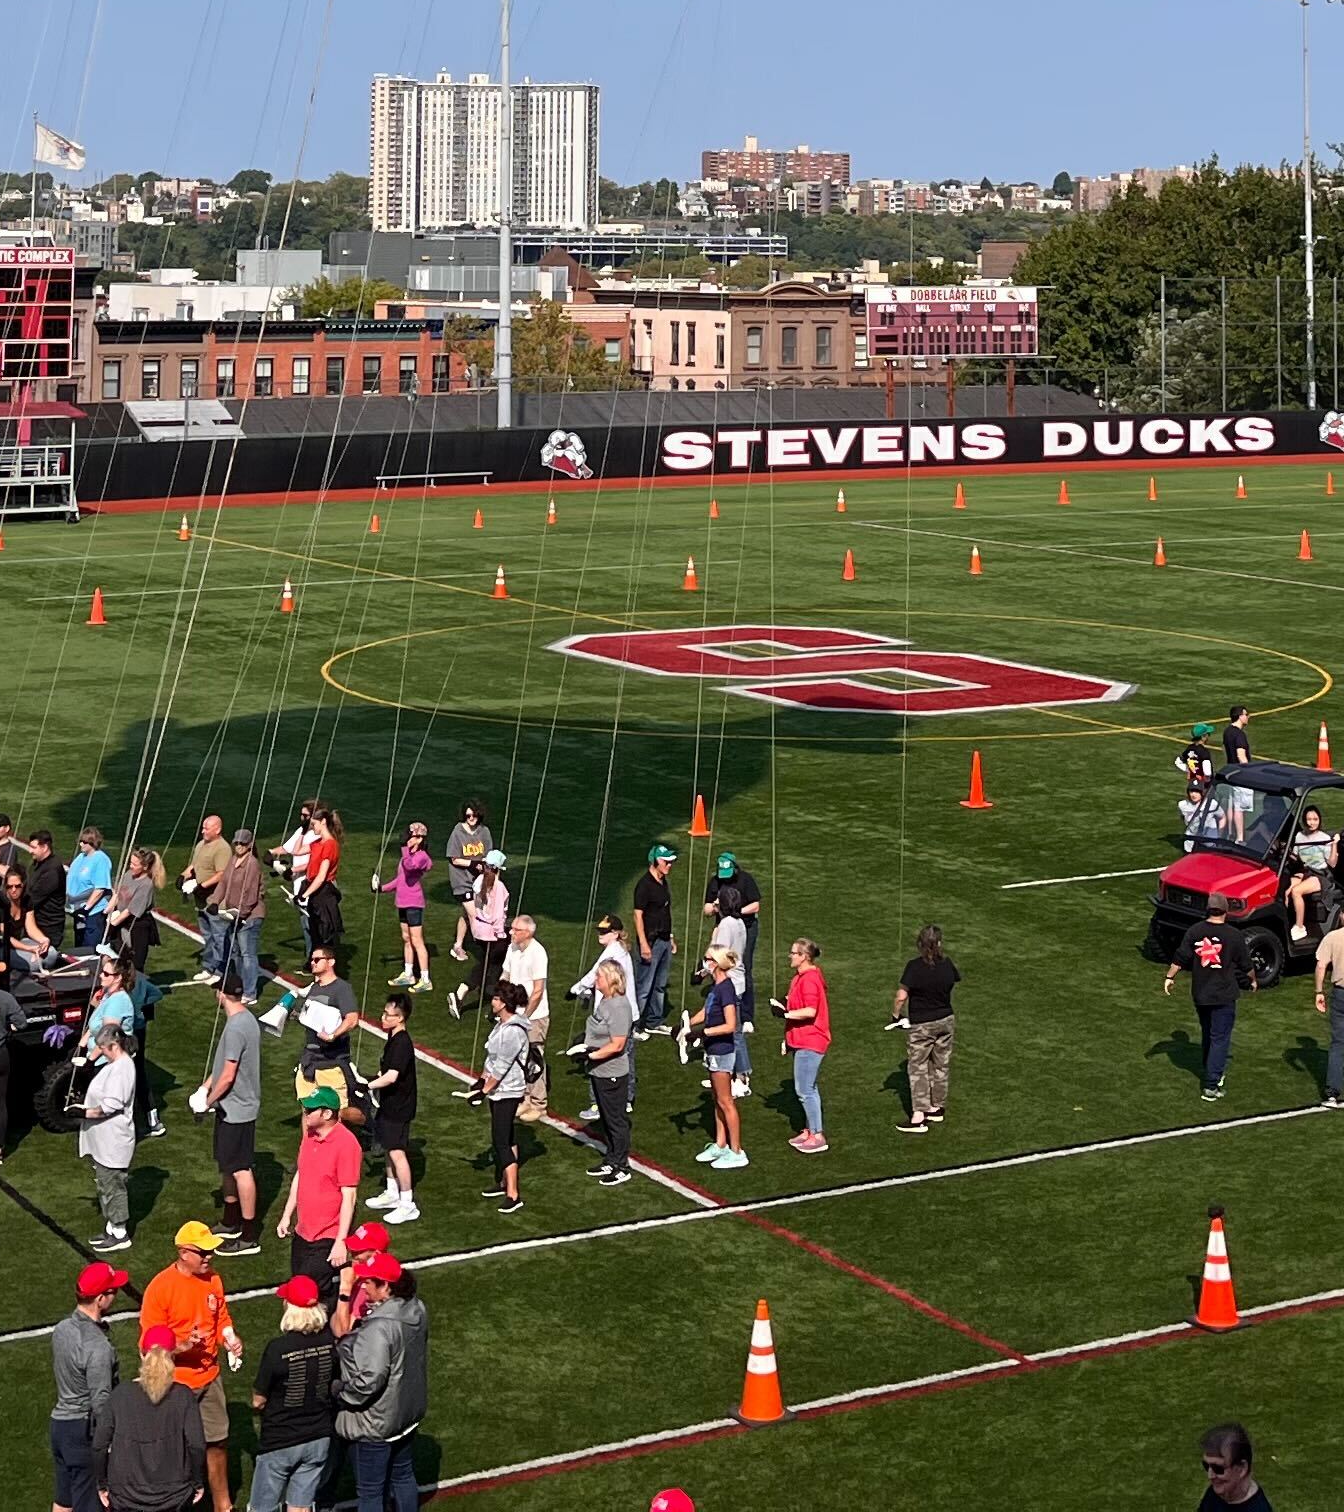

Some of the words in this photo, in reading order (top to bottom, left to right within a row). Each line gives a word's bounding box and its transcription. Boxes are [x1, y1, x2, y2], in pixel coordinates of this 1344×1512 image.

[18, 250, 70, 263] COMPLEX
[910, 289, 968, 301] DOBBELAAR
[971, 289, 997, 300] FIELD
[662, 424, 1006, 470] STEVENS
[1043, 417, 1274, 457] DUCKS
